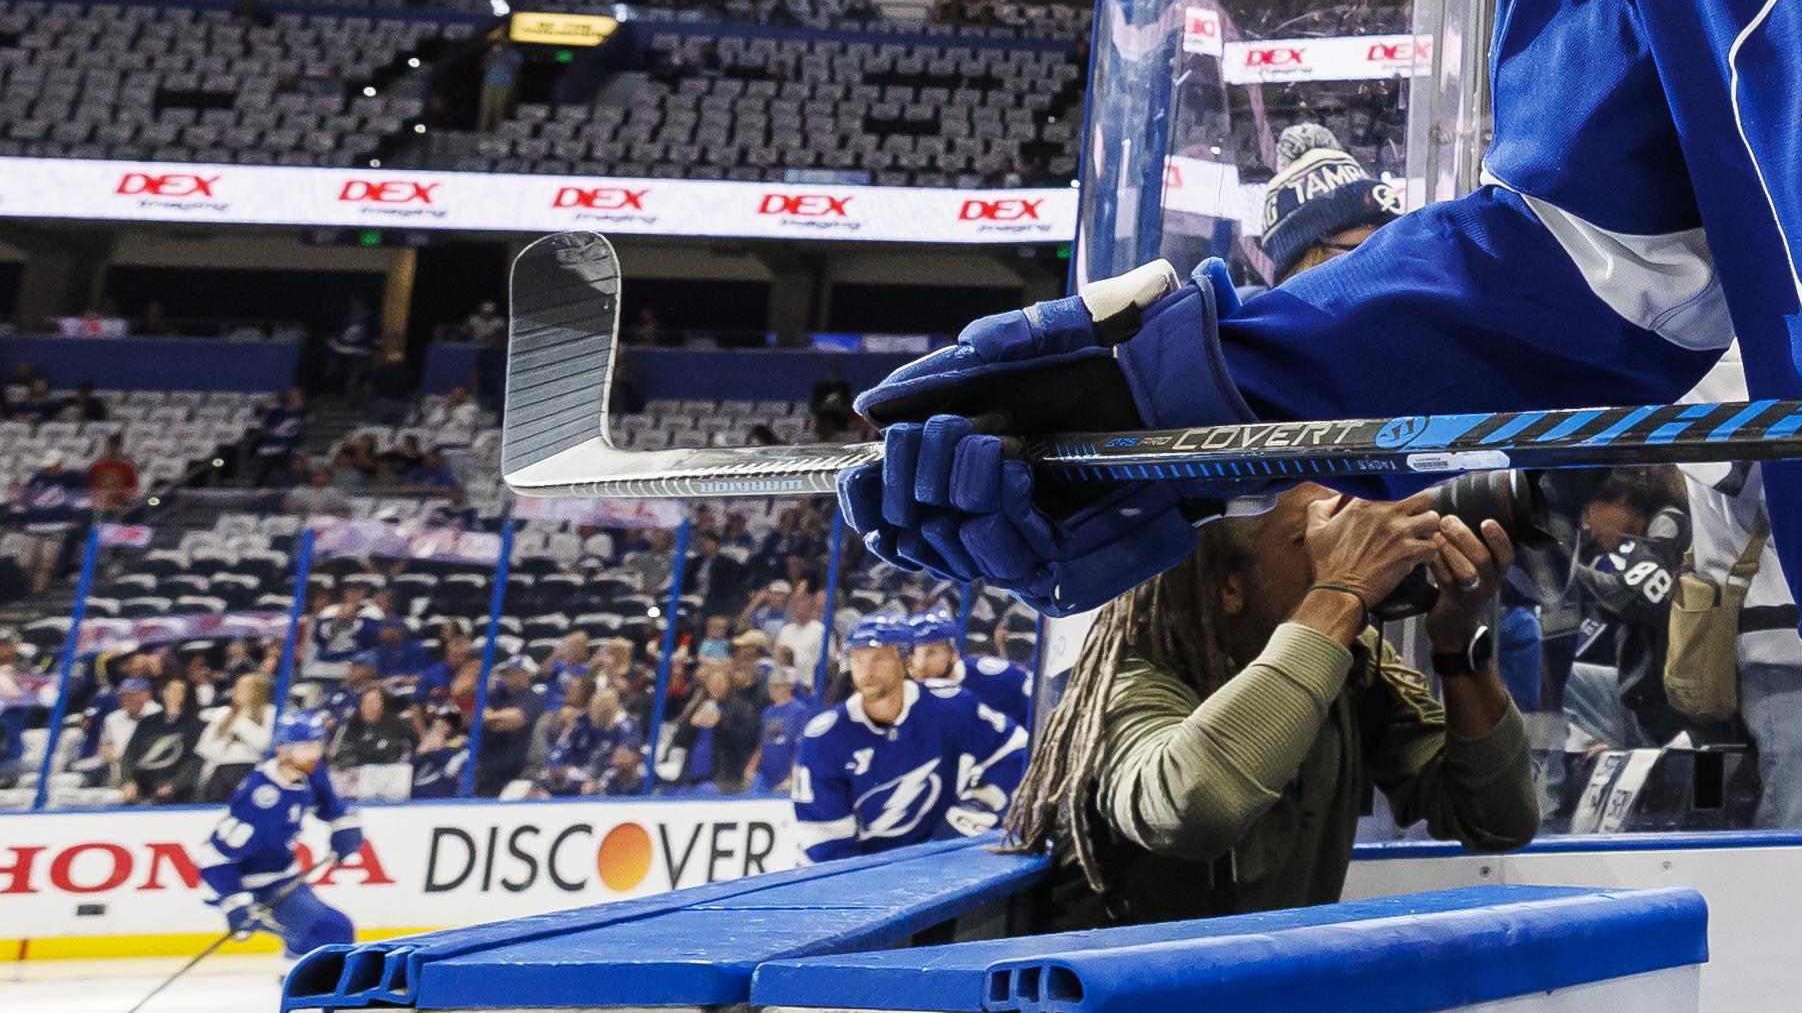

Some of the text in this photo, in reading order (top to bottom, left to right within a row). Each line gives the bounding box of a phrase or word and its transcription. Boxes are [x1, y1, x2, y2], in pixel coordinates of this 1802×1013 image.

[115, 173, 222, 197] DEX
[337, 180, 443, 203] DEX
[1285, 164, 1368, 205] TAMP
[552, 187, 652, 210] DEX
[757, 193, 854, 216] DEX
[958, 199, 1046, 220] DEX
[1172, 419, 1366, 451] COVERT
[1624, 560, 1673, 604] 88
